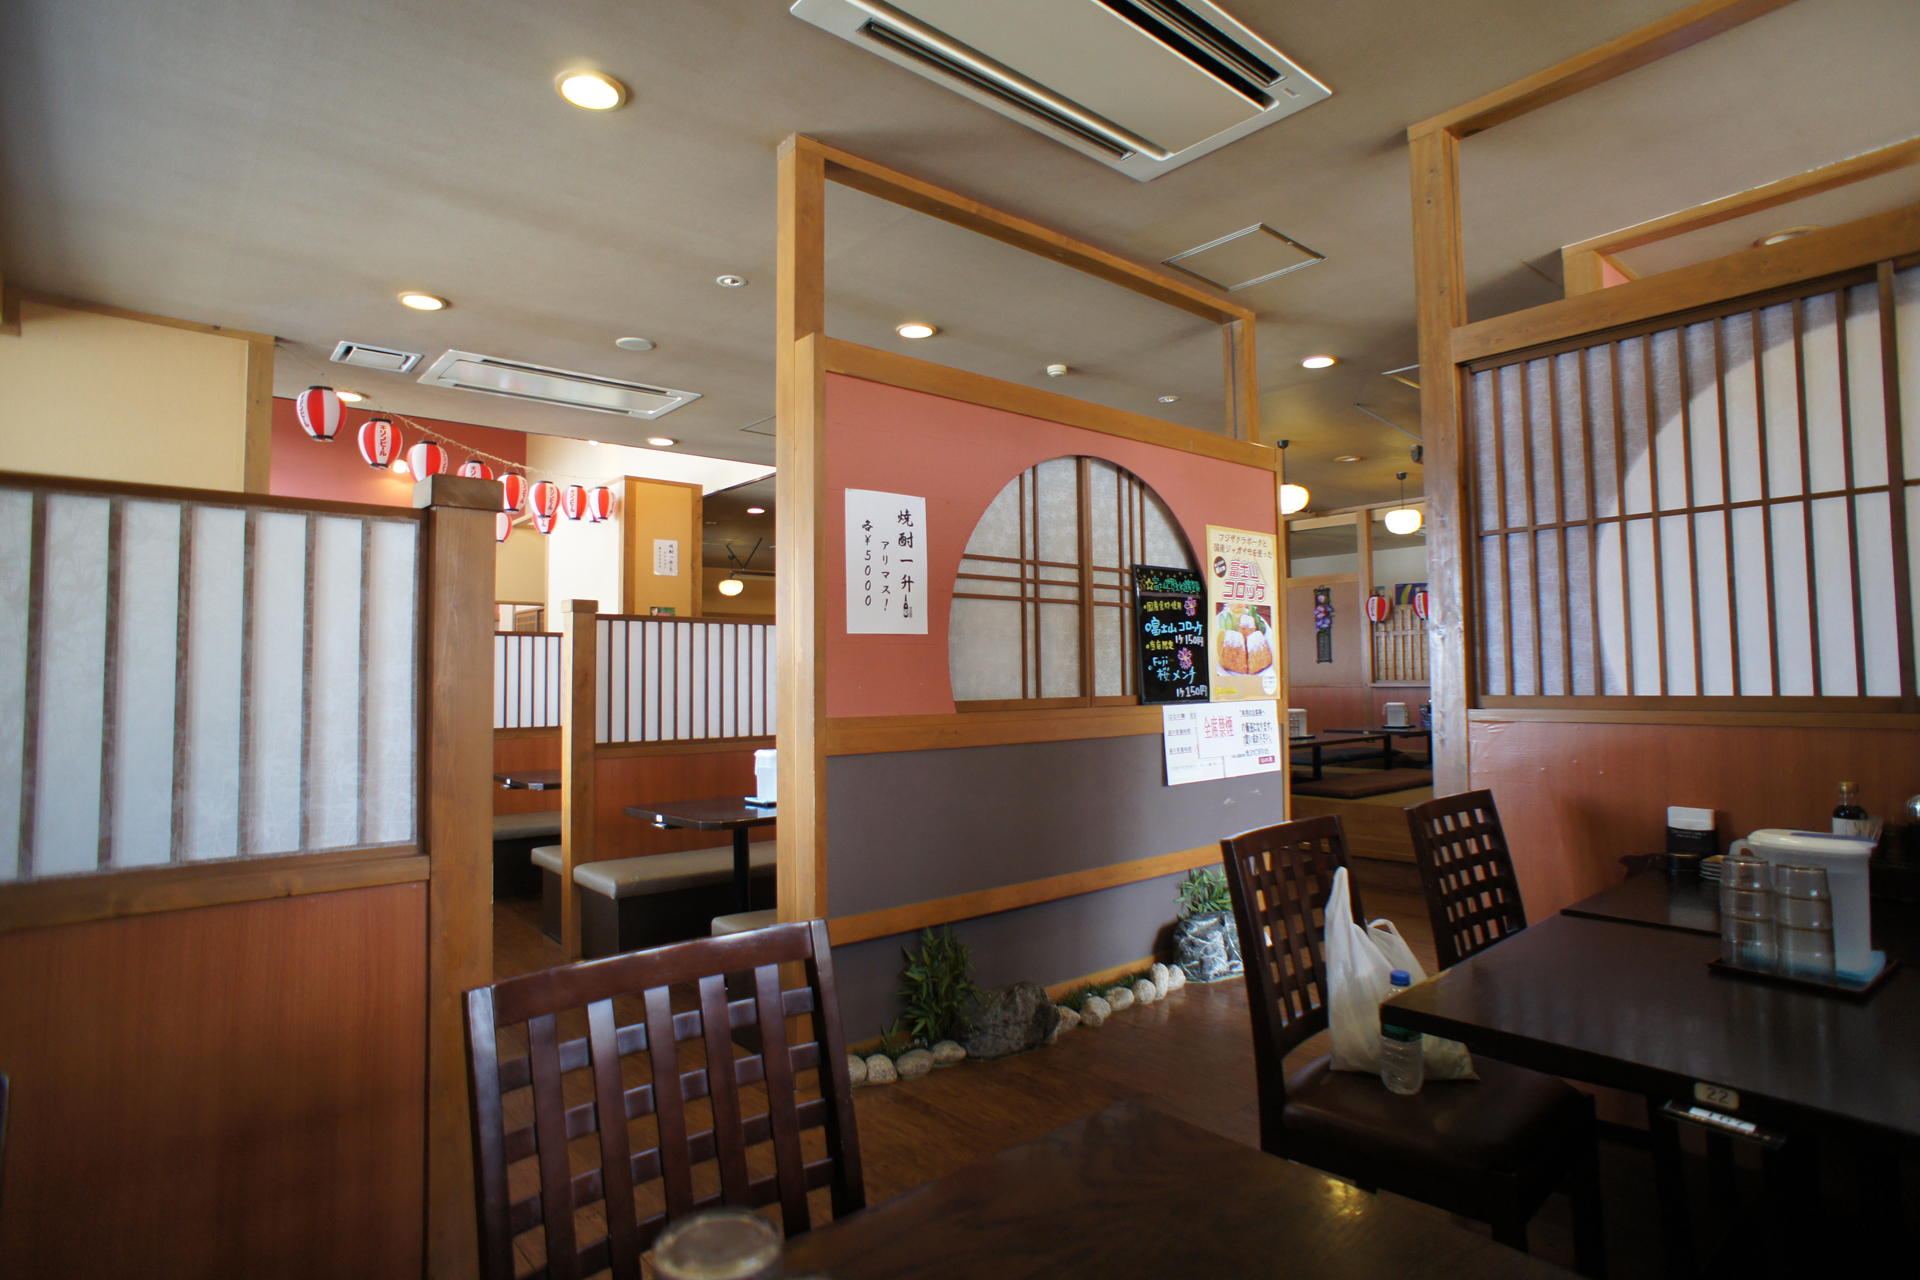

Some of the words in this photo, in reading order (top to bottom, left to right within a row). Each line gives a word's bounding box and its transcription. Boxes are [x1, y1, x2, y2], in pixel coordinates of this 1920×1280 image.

[379, 424, 388, 457] キリンビール
[898, 508, 915, 593] 焼酎一升
[1229, 559, 1260, 581] 富士山
[1222, 579, 1266, 603] コロッケ
[1152, 656, 1169, 667] Fuji
[1156, 665, 1196, 684] 桜メンチ
[1204, 715, 1234, 739] 全席禁煙
[1706, 1086, 1730, 1105] 22
